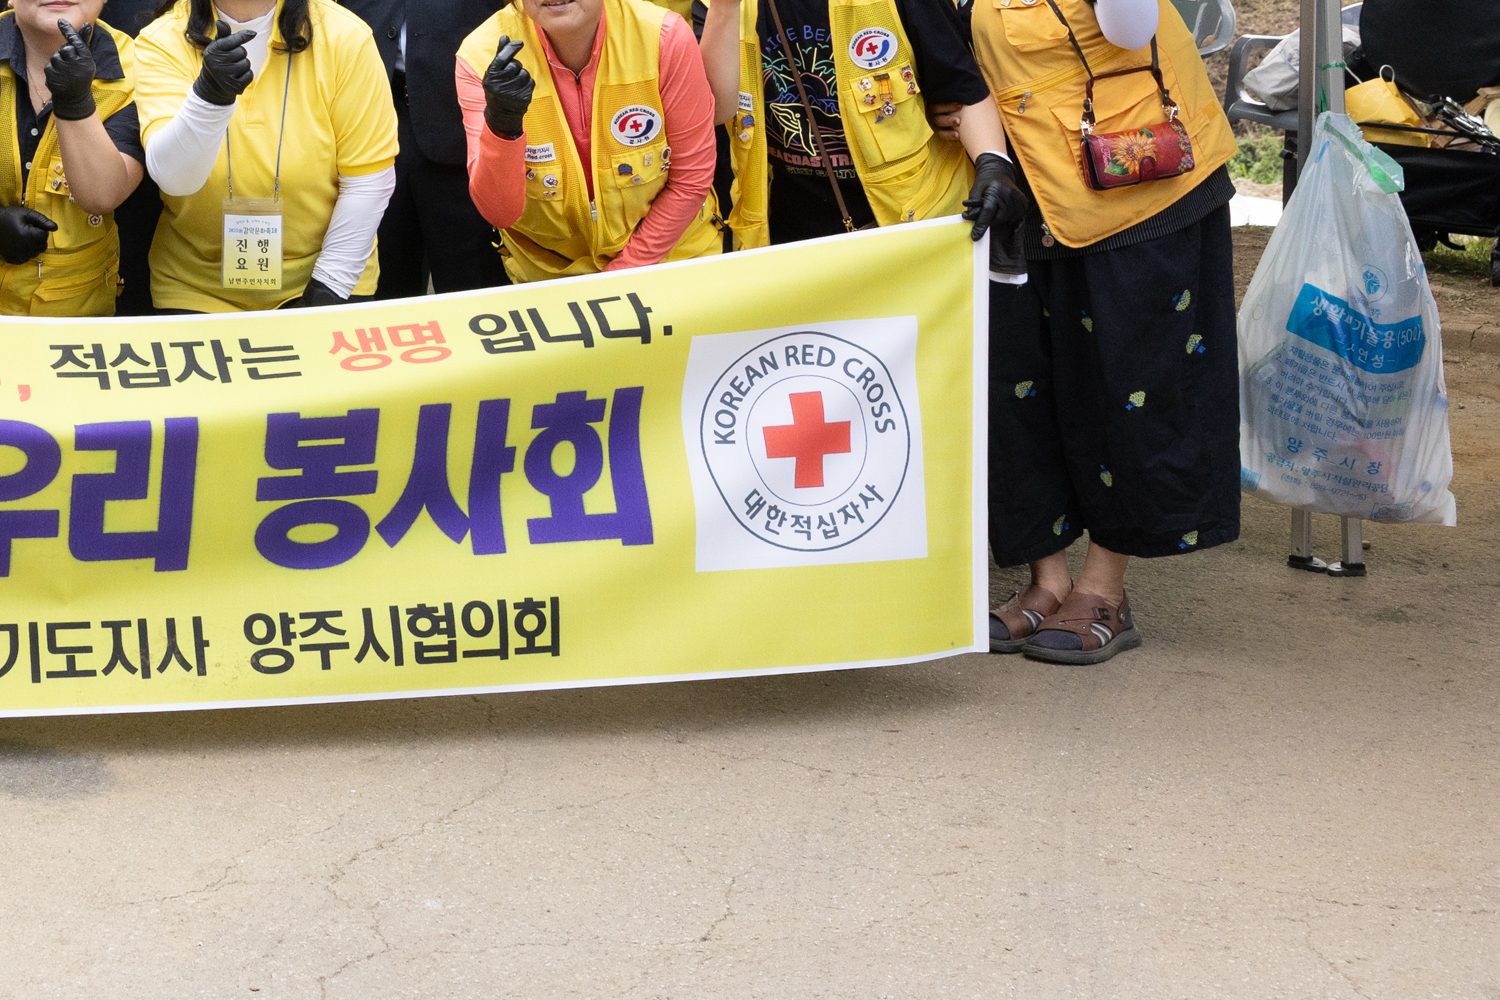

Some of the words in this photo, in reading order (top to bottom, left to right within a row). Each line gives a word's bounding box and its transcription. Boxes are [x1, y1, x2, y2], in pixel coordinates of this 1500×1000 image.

[49, 338, 302, 390] 적십자는
[328, 320, 454, 372] 생명
[468, 292, 673, 354] 입니다.
[713, 350, 780, 445] KOREAN
[784, 344, 837, 367] RED
[842, 357, 896, 434] CROSS
[1280, 370, 1304, 386] 버려야
[1318, 373, 1345, 391] 반드시
[254, 385, 655, 570] 봉사회
[1287, 436, 1303, 453] 양
[1312, 446, 1328, 461] 주
[1339, 457, 1356, 470] 시
[1367, 461, 1382, 475] 장
[743, 483, 885, 541] 대한적십자사
[243, 596, 561, 676] 양주시협의회
